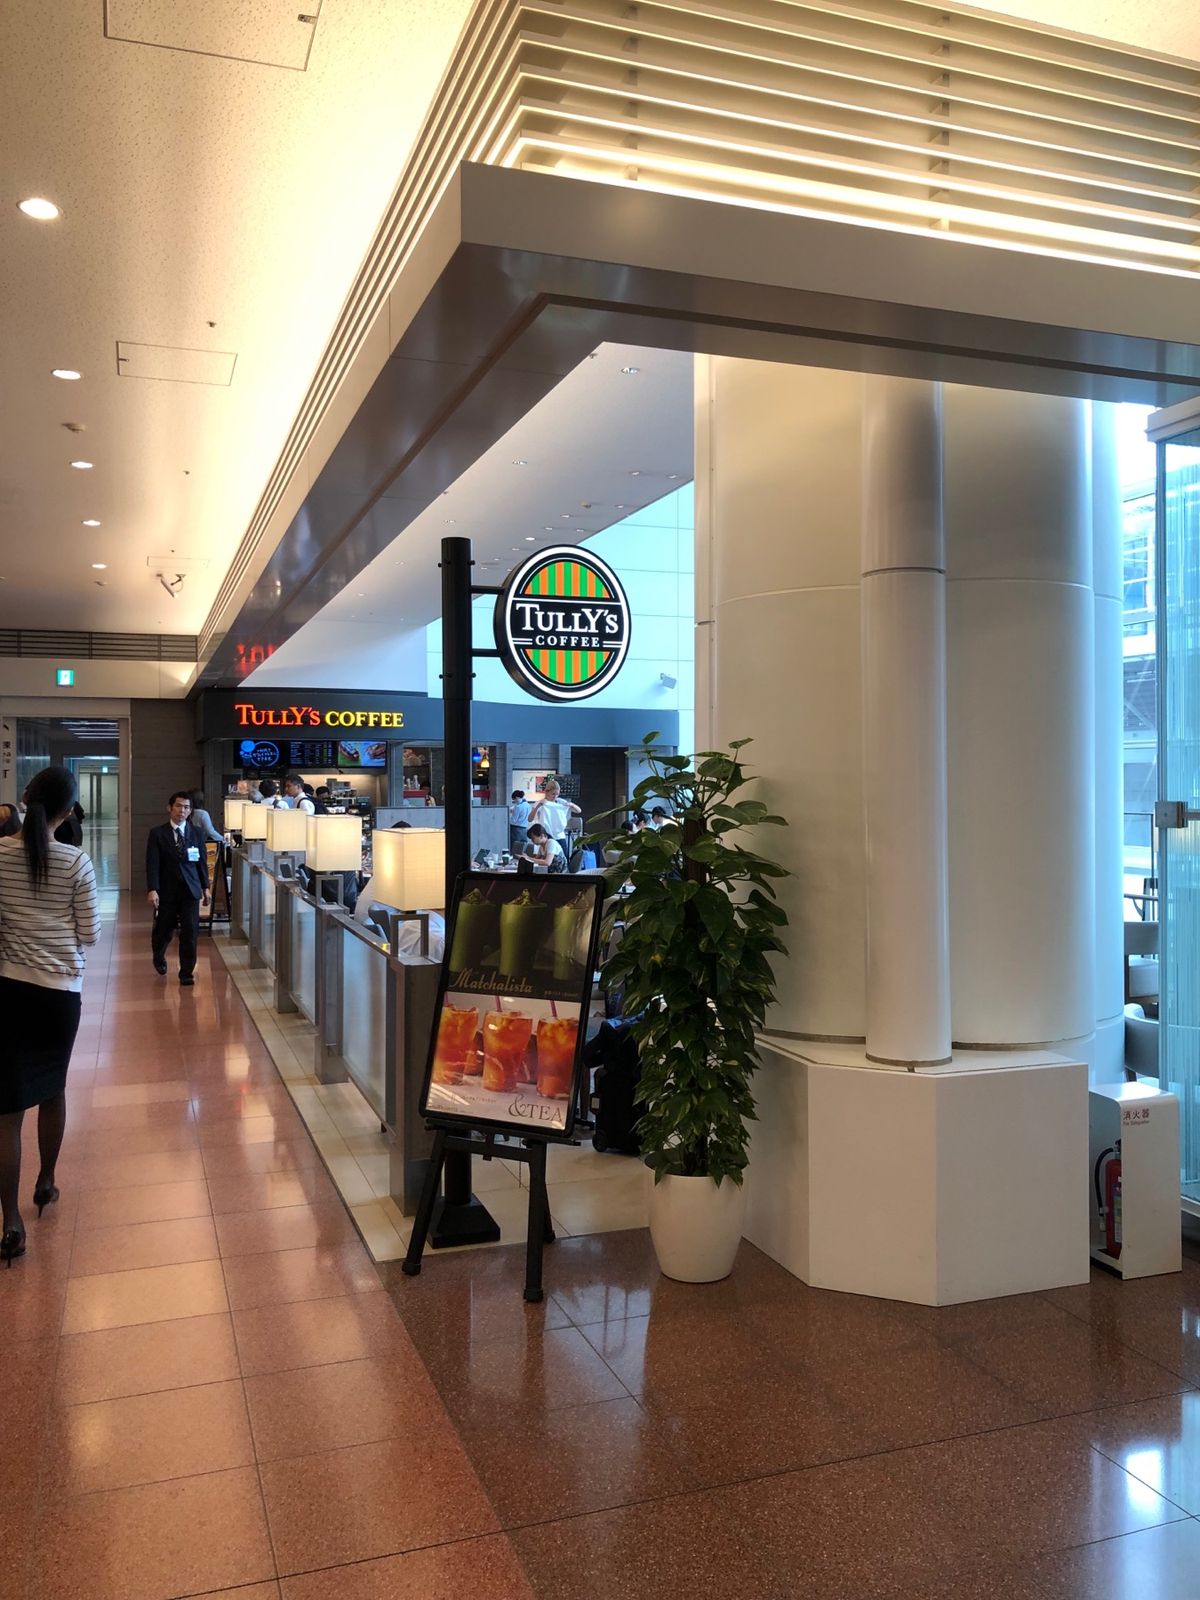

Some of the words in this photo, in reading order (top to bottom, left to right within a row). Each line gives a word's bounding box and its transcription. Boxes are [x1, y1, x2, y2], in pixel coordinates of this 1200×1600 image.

[535, 635, 600, 648] COFFEE
[325, 711, 404, 727] COFFEE
[449, 967, 534, 993] Matchalista
[1123, 1108, 1150, 1120] 消火器
